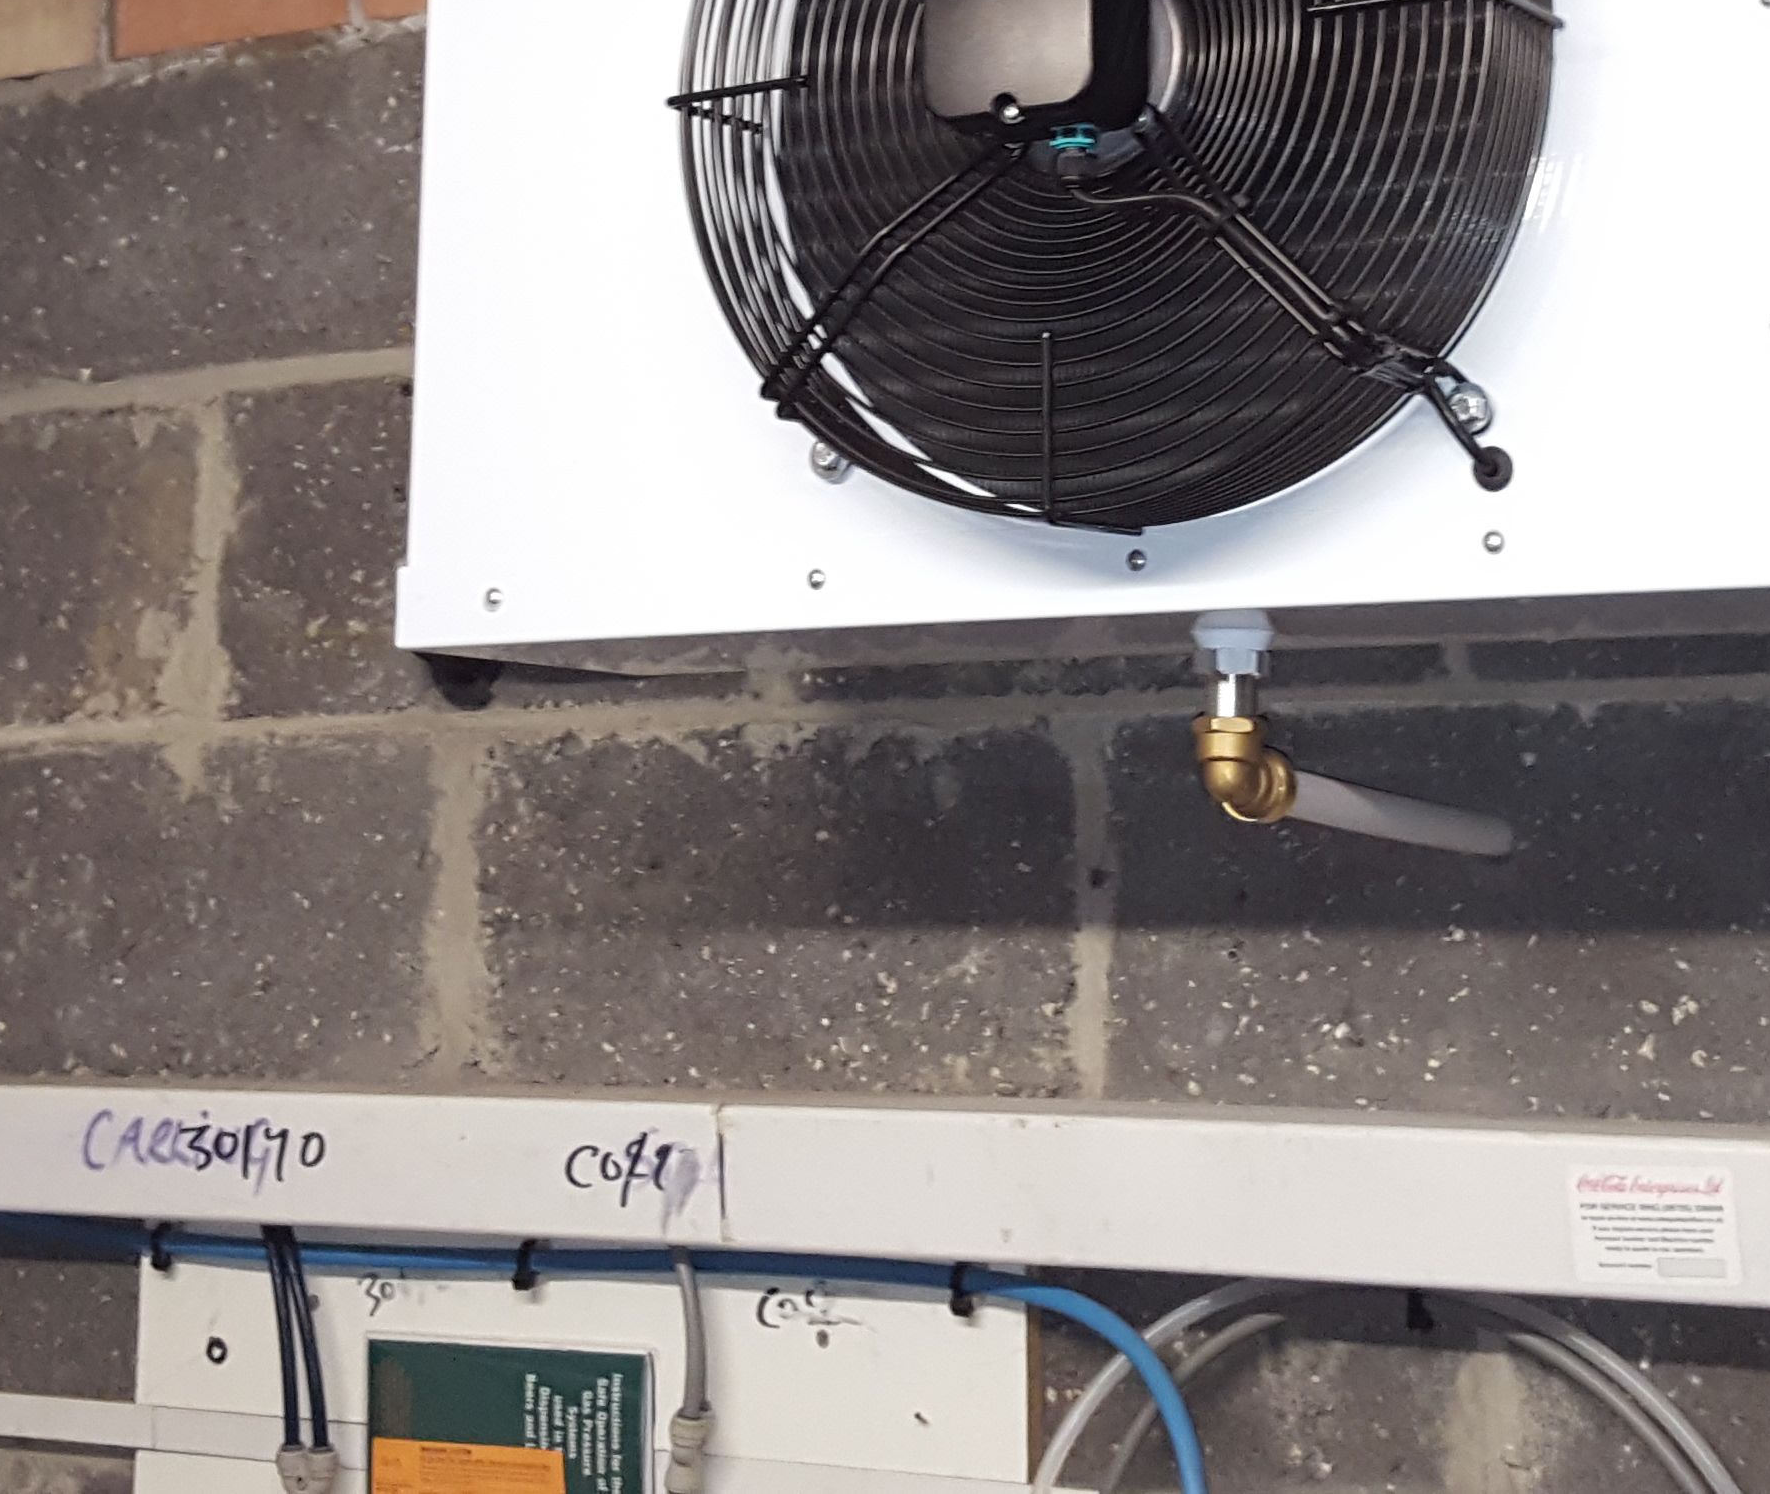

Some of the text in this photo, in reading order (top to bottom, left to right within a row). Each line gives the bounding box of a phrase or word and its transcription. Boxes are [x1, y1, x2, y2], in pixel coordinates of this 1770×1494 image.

[538, 1386, 551, 1450] Dispensin
[566, 1406, 579, 1459] Systems
[581, 1390, 594, 1476] Gas Pressure
